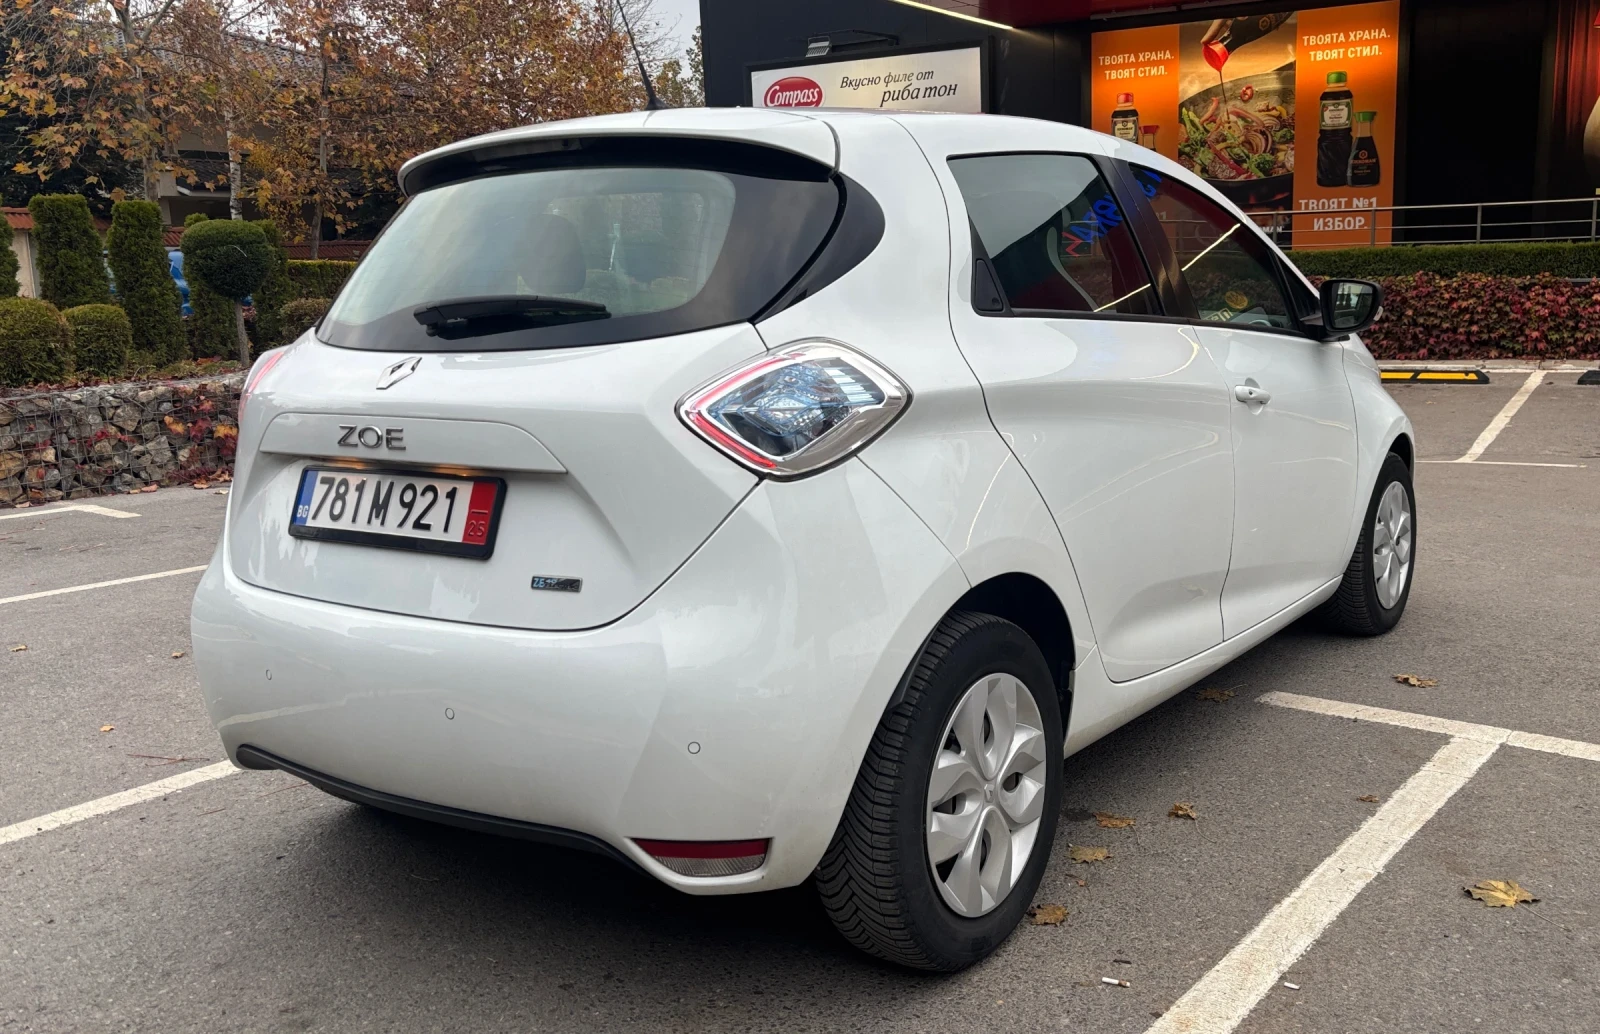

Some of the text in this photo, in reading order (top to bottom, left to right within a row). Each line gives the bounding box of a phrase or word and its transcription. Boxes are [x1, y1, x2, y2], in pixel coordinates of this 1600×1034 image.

[1302, 28, 1390, 46] ТВОЯТА ХРАНА.
[1099, 50, 1174, 66] ТВОЯТА ХРАНА.
[1309, 45, 1382, 61] ТВОЯТ СТИЛ.
[840, 70, 935, 89] Вкусно филе от
[1105, 65, 1168, 80] ТВОЯТ СТИЛ.
[766, 85, 820, 107] Compass
[880, 83, 958, 107] риба тон
[1299, 197, 1377, 211] ТВОЯТ №1
[1313, 217, 1367, 231] ИЗБОР.
[337, 424, 406, 450] ZOE
[297, 476, 459, 534] BG 781M921
[467, 520, 486, 536] 25
